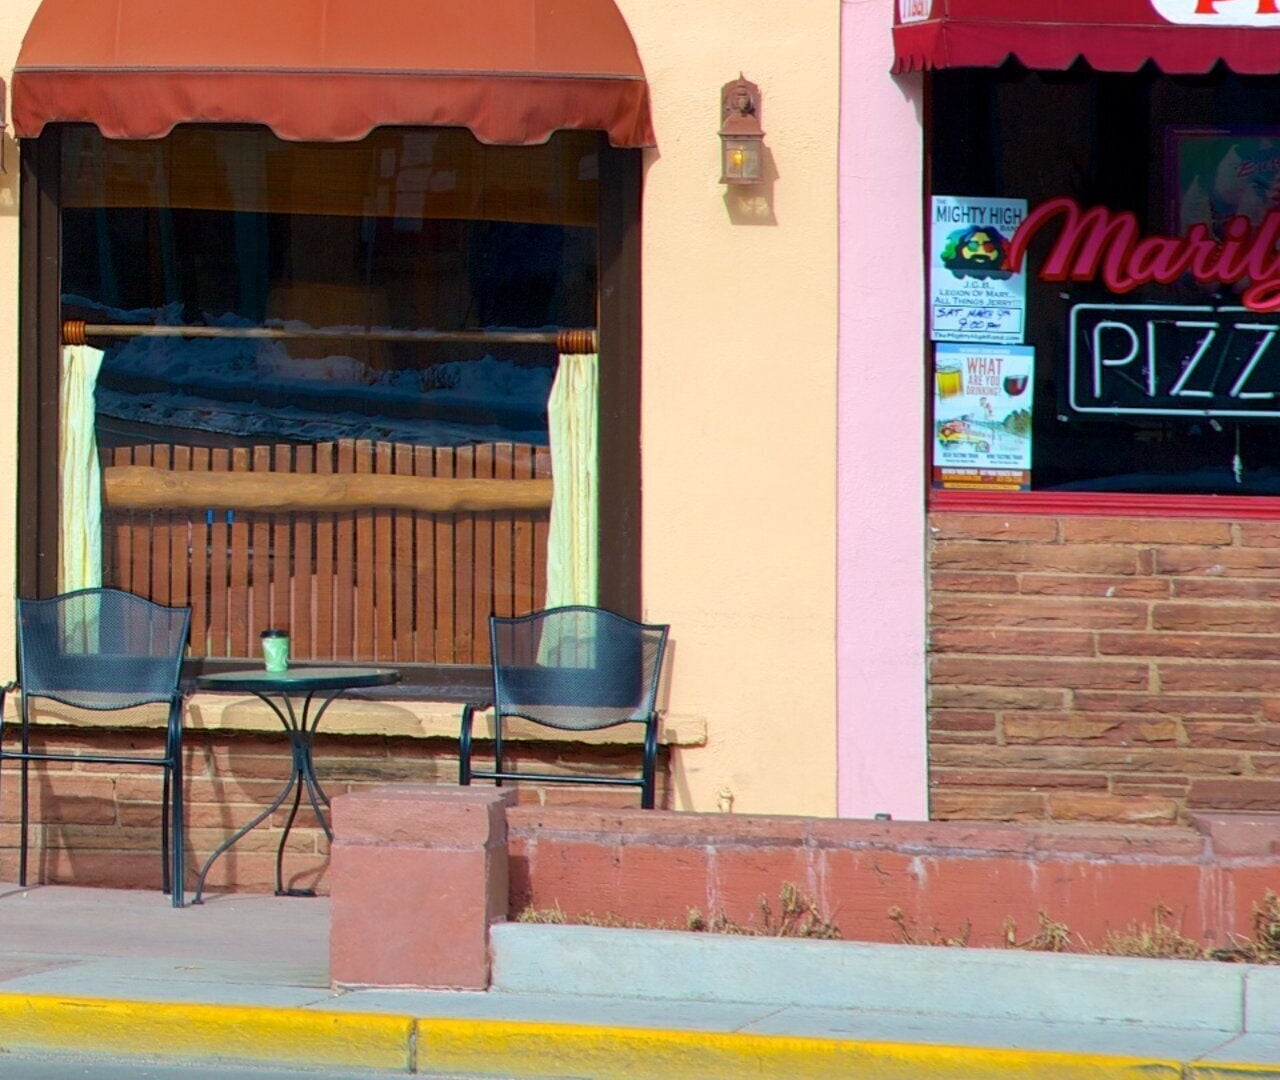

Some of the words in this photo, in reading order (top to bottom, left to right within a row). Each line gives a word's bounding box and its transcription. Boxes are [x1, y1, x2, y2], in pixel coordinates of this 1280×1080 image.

[936, 205, 986, 224] MIGHTY
[990, 207, 1022, 225] HIGH
[966, 357, 1004, 376] WHAT
